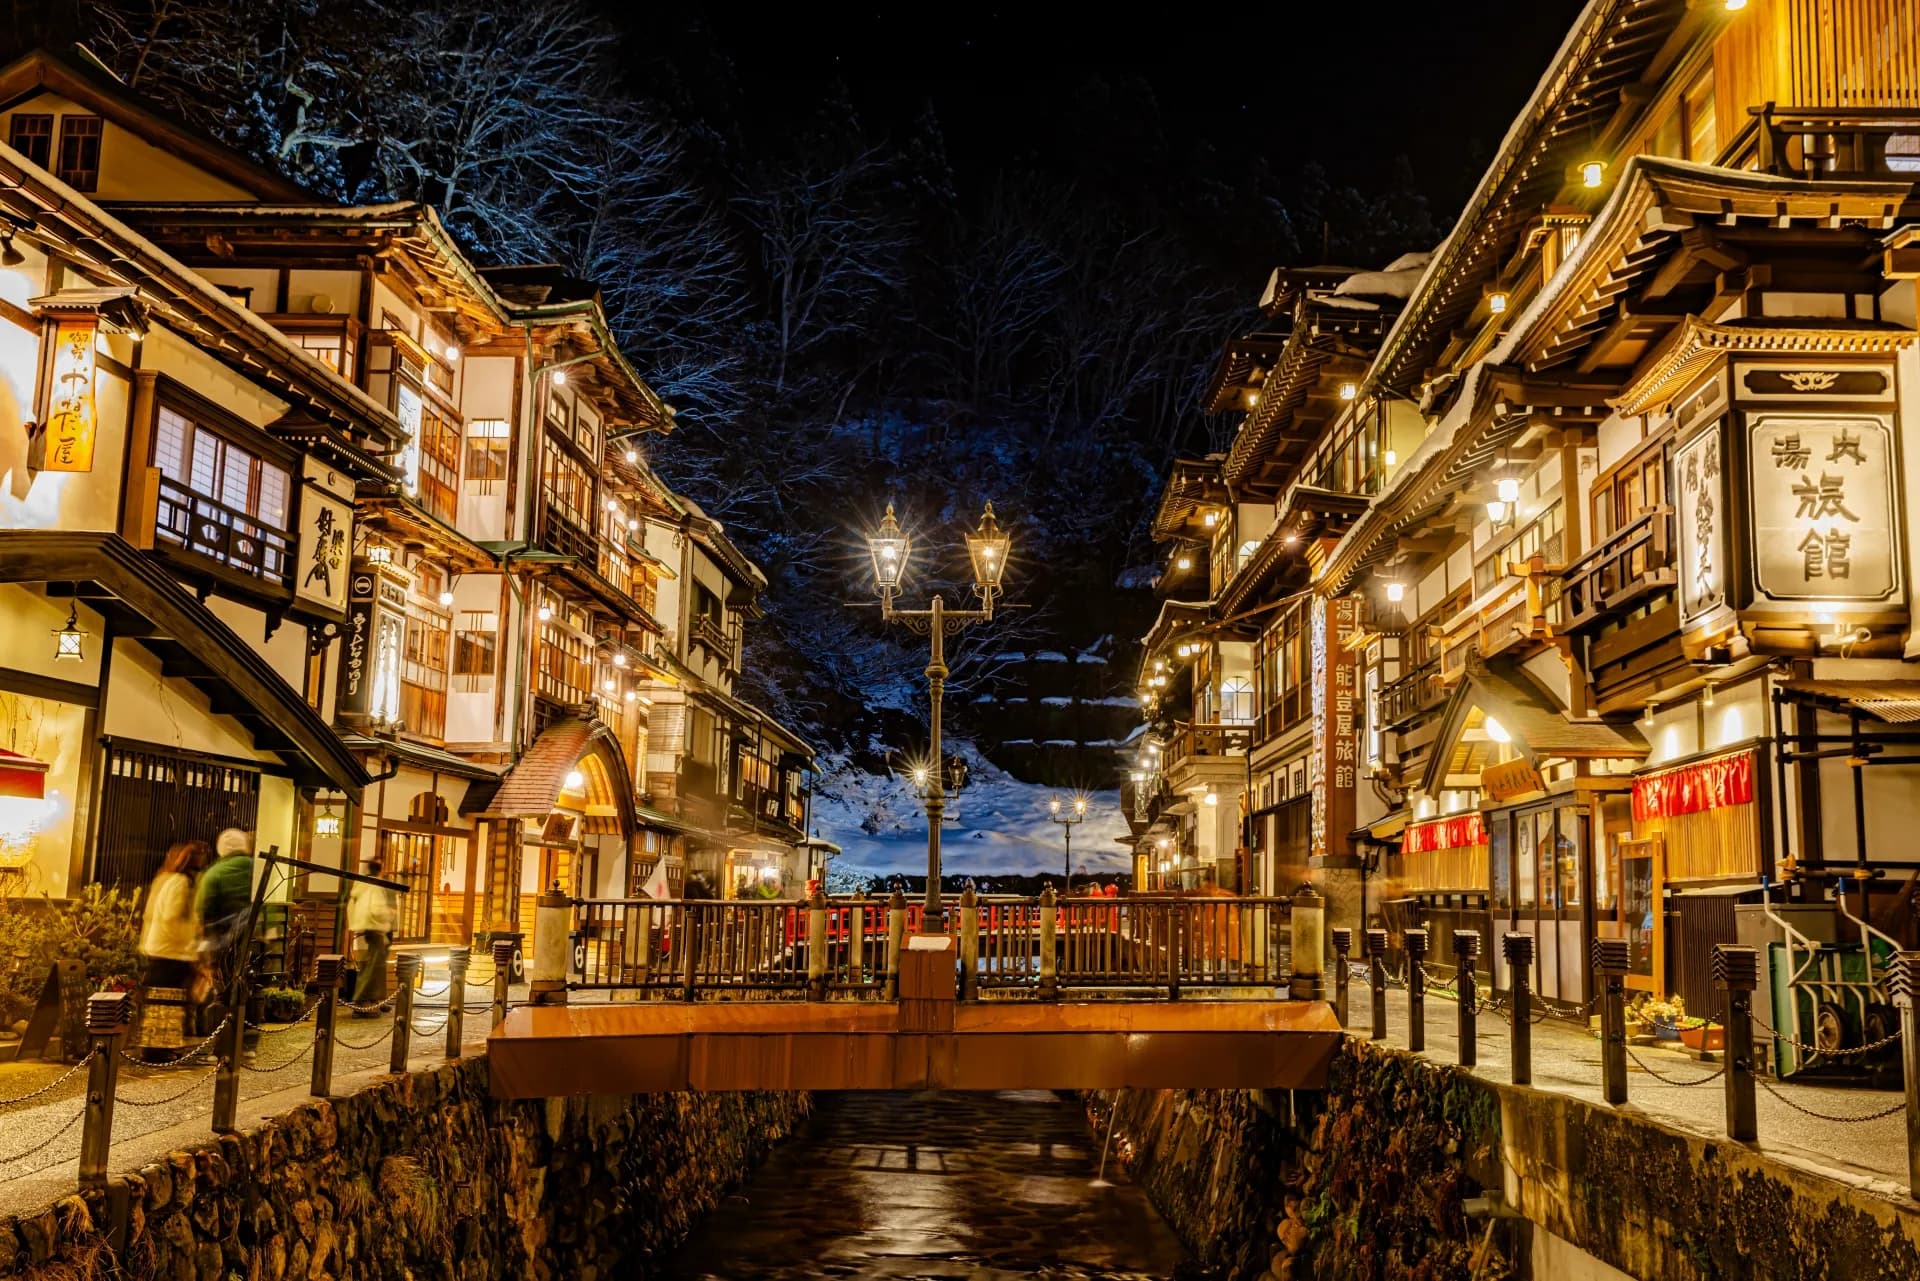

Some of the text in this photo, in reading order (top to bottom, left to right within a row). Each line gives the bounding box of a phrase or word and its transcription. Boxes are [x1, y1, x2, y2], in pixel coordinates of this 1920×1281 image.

[1335, 663, 1354, 788] 能登屋旅館
